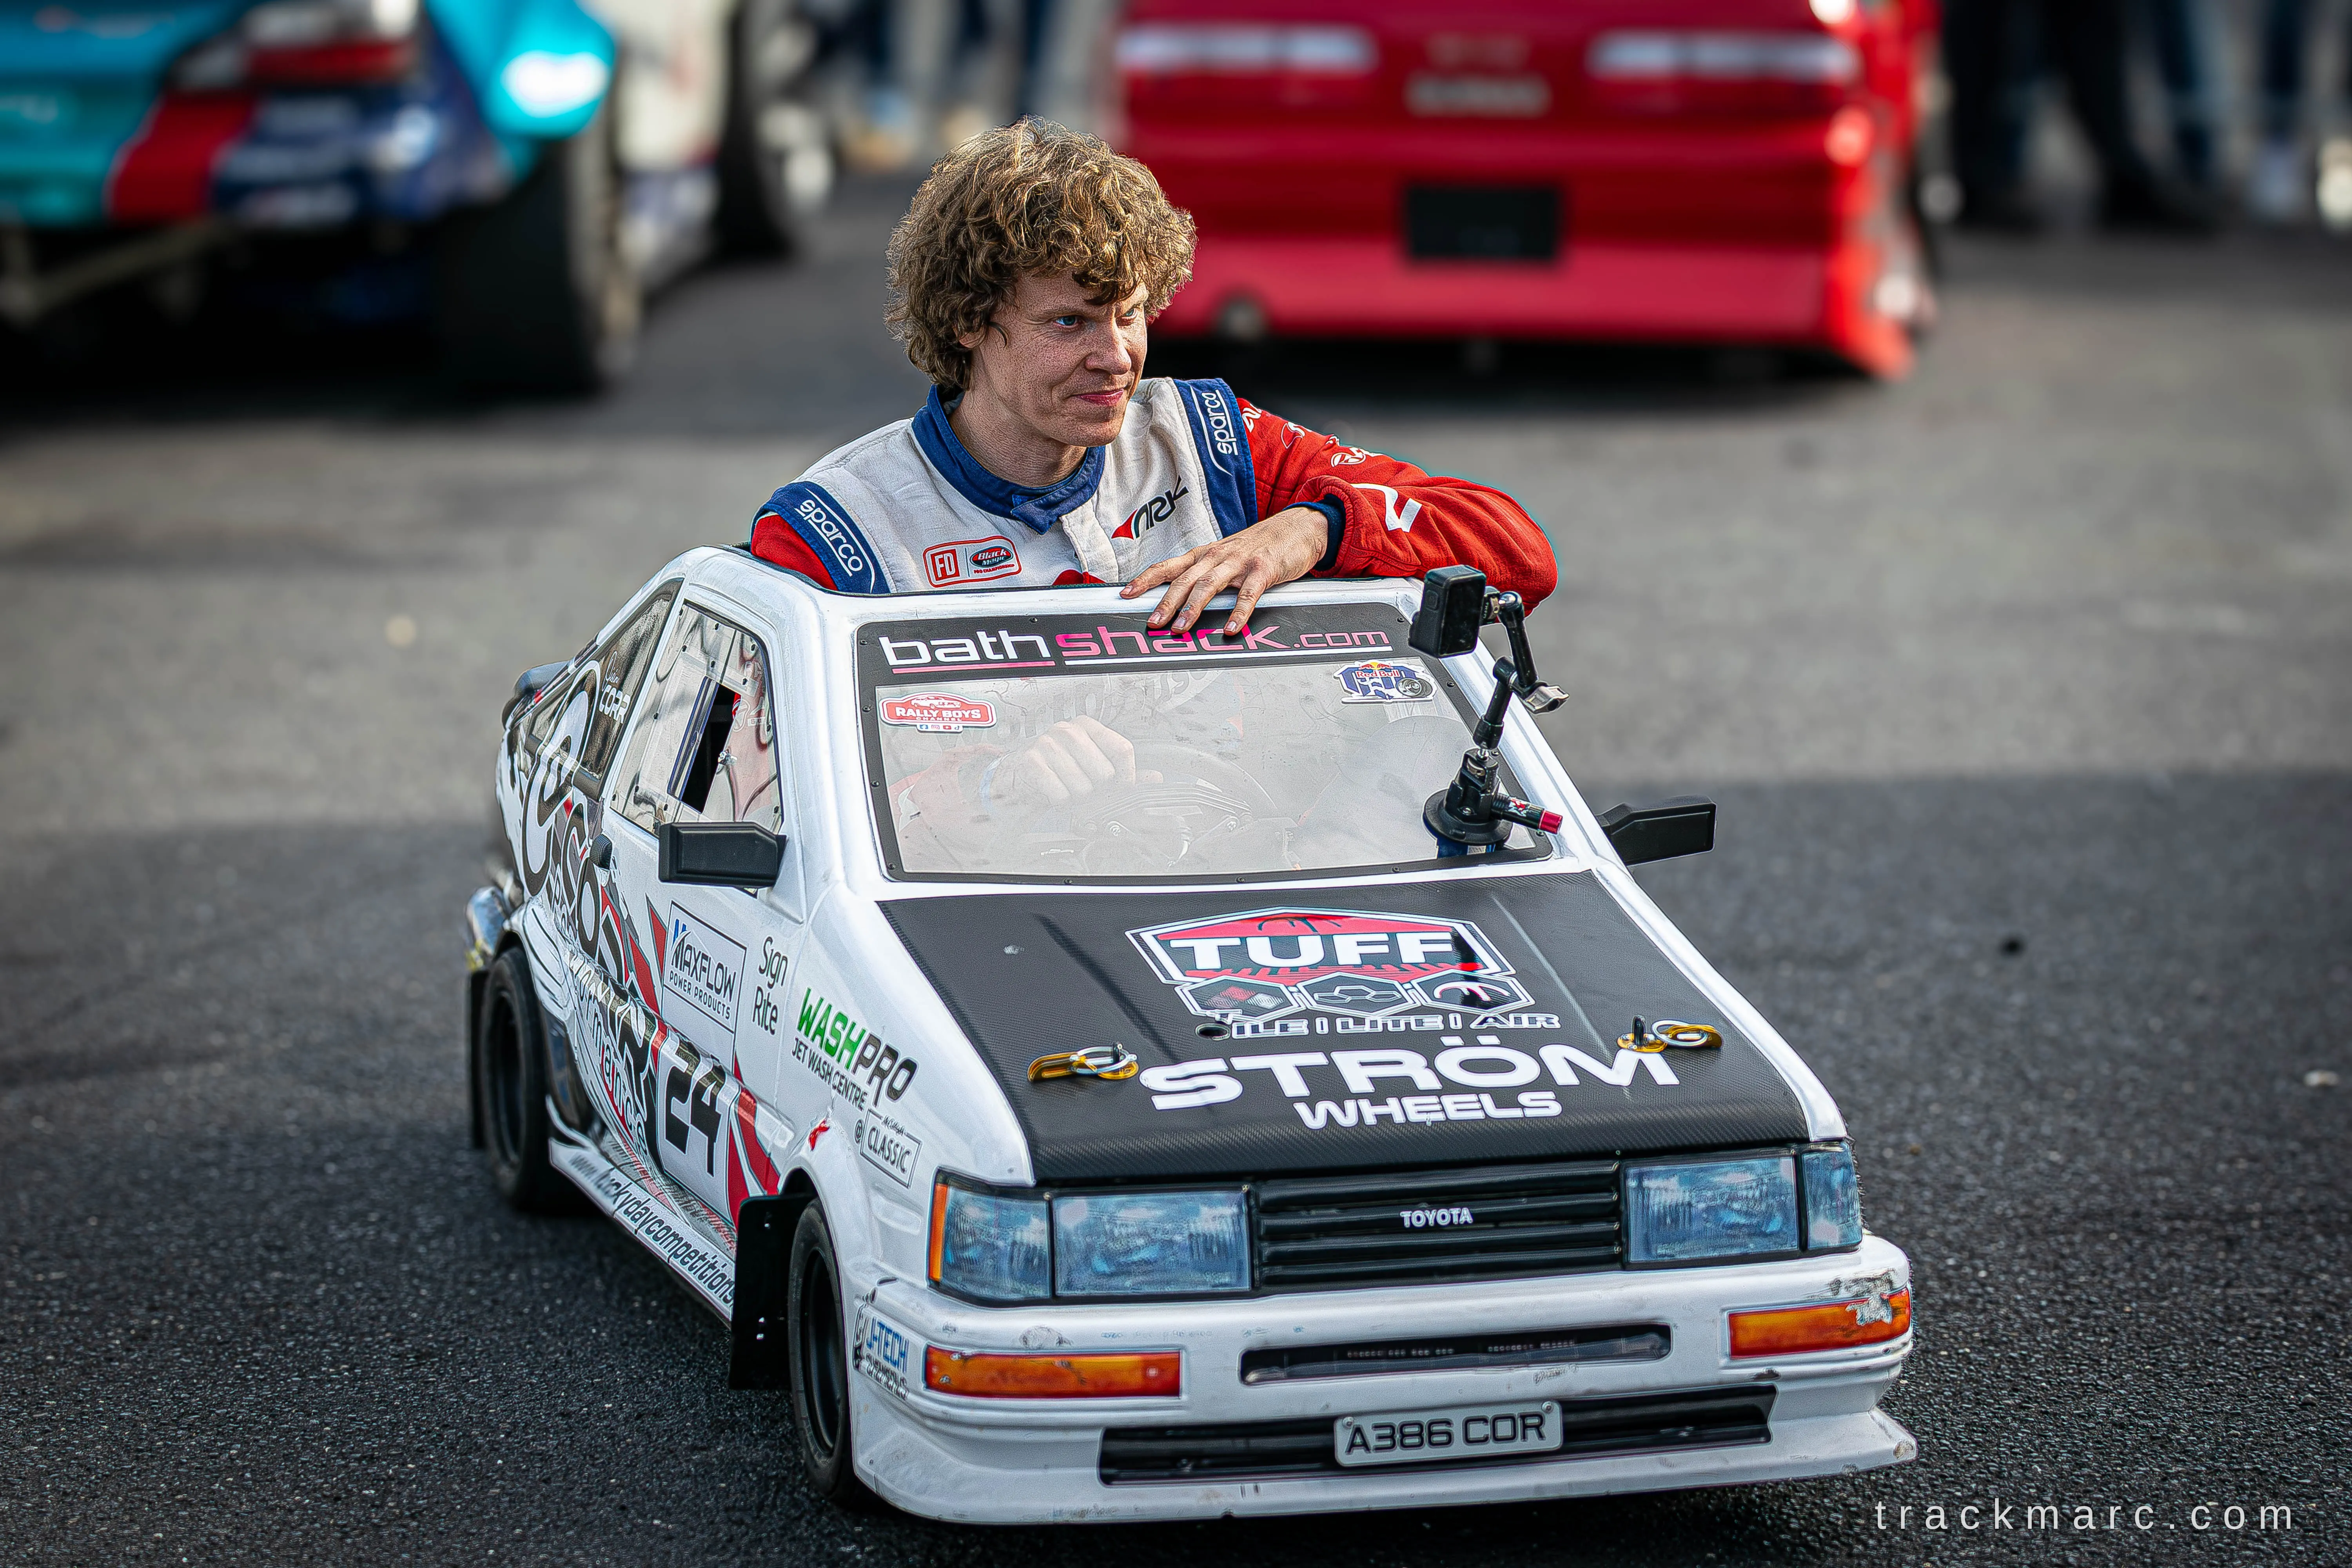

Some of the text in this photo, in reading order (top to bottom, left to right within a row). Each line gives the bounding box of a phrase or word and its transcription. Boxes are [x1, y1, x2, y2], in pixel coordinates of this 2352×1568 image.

[1202, 392, 1237, 455] sparco
[800, 499, 863, 572] sparco
[978, 549, 1007, 560] Black
[935, 552, 956, 577] FD
[982, 556, 1006, 566] Magic
[983, 564, 1015, 573] CHAMPIONSHIP
[599, 684, 631, 724] CORR
[895, 706, 981, 719] RALLY BOYS
[671, 939, 737, 1002] MAXFLOW
[759, 936, 788, 989] Sign
[1169, 931, 1457, 970] TUFF
[669, 970, 731, 1019] POWER PRODUCTS
[753, 987, 779, 1035] Rite
[1470, 1013, 1562, 1029] AIR
[791, 1038, 868, 1112] JET WASH CENTRE
[1139, 1035, 1681, 1111] STRÖM
[665, 1037, 726, 1177] 24
[1293, 1091, 1562, 1129] WHEELS
[867, 1127, 911, 1174] CLASSIC
[1400, 1207, 1473, 1228] TOYOTA
[1345, 1412, 1547, 1455] A386 COR
